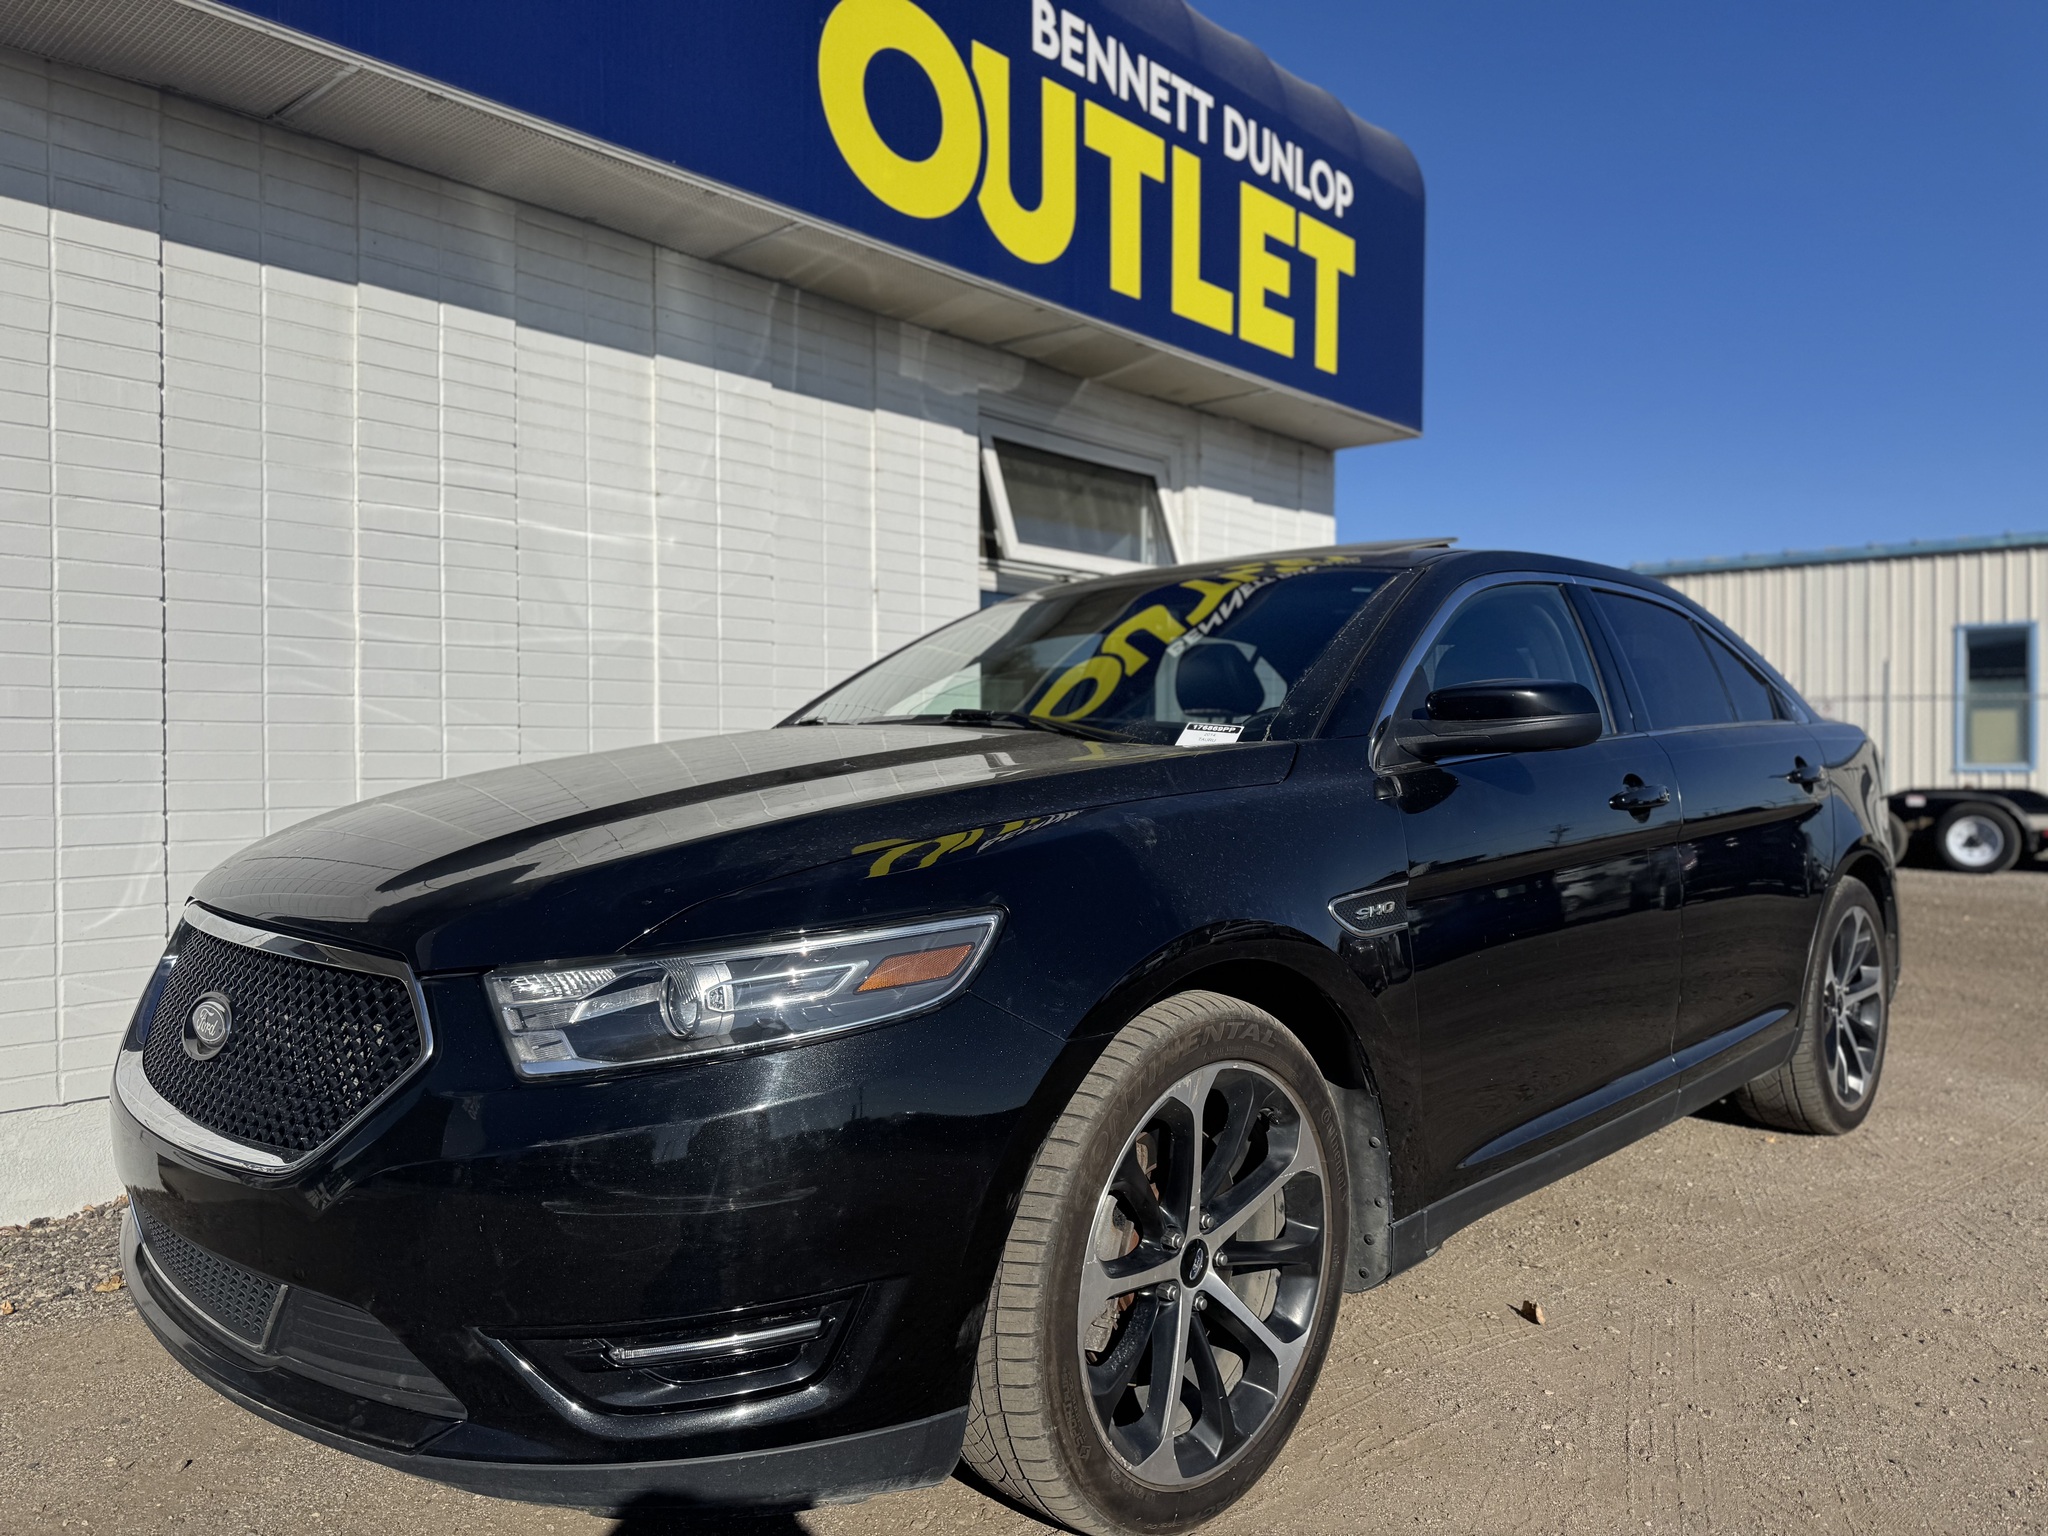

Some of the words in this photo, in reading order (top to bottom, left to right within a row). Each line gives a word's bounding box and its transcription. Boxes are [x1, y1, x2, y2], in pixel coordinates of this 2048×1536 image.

[818, 0, 1356, 375] OUTLET
[1032, 0, 1214, 144] BENNETT
[1223, 104, 1354, 218] DUNLOP
[196, 1008, 218, 1036] Ford
